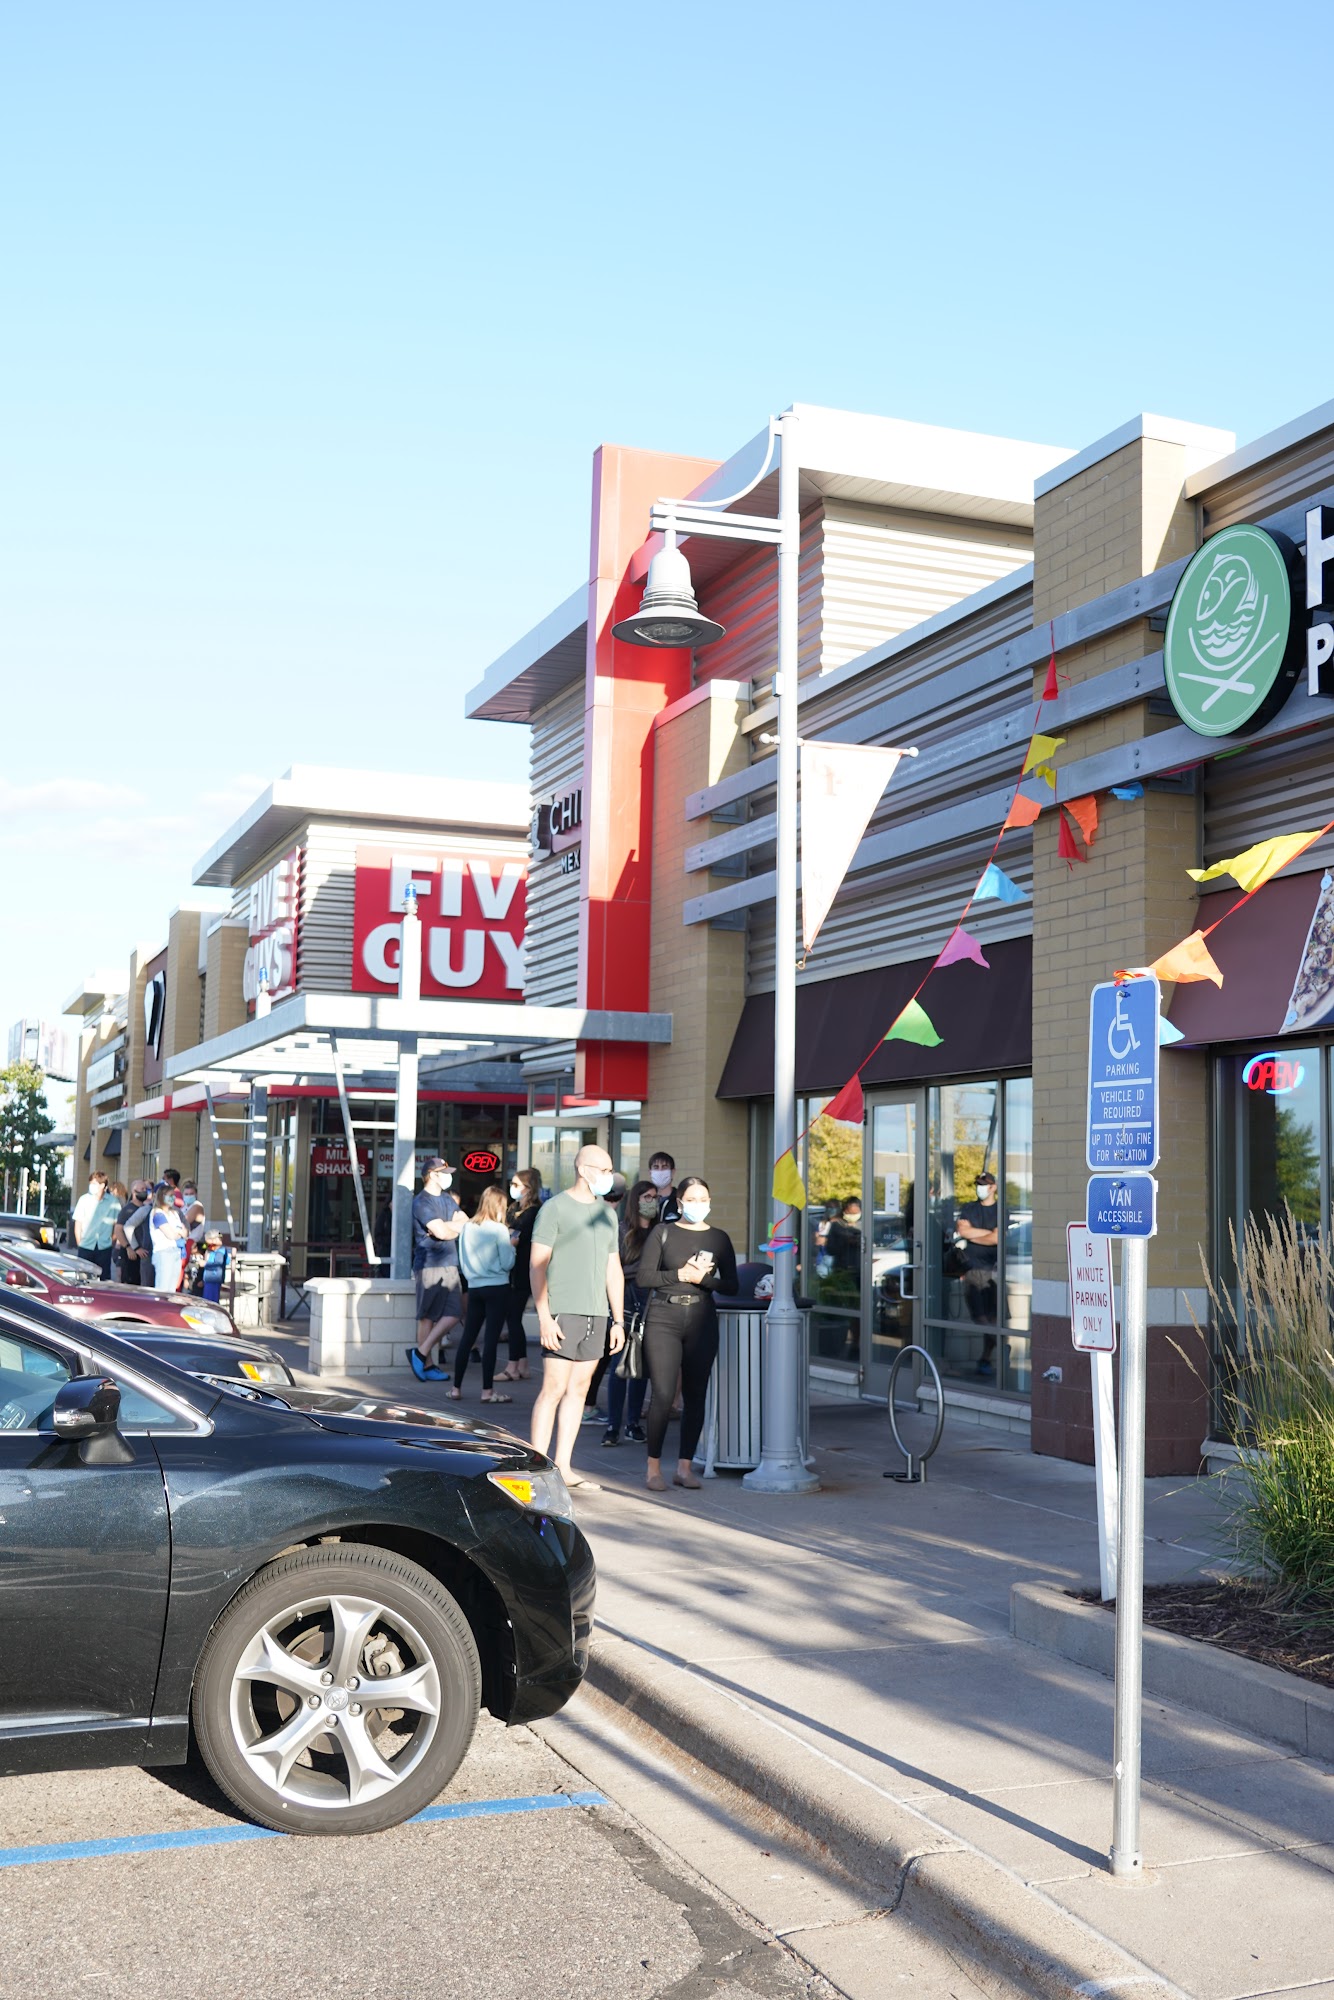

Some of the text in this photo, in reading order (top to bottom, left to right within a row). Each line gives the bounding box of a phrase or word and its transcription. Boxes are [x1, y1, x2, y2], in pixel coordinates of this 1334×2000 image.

[561, 848, 581, 874] MEX
[390, 854, 526, 920] FIV
[1105, 1062, 1140, 1077] PARKING
[1247, 1061, 1300, 1091] OPEN
[1100, 1089, 1144, 1103] VEHICLE ID
[1103, 1106, 1141, 1119] REQUIRED
[1091, 1132, 1152, 1146] UP TO $200 FINE
[464, 1154, 497, 1170] OPEN
[1096, 1149, 1110, 1161] FOR
[1109, 1189, 1132, 1206] VAN
[1097, 1211, 1143, 1223] ACCESSIBLE
[1085, 1243, 1093, 1257] 15
[1076, 1267, 1104, 1283] MINUTE
[1075, 1291, 1108, 1308] PARKING
[1082, 1316, 1103, 1332] ONLY
